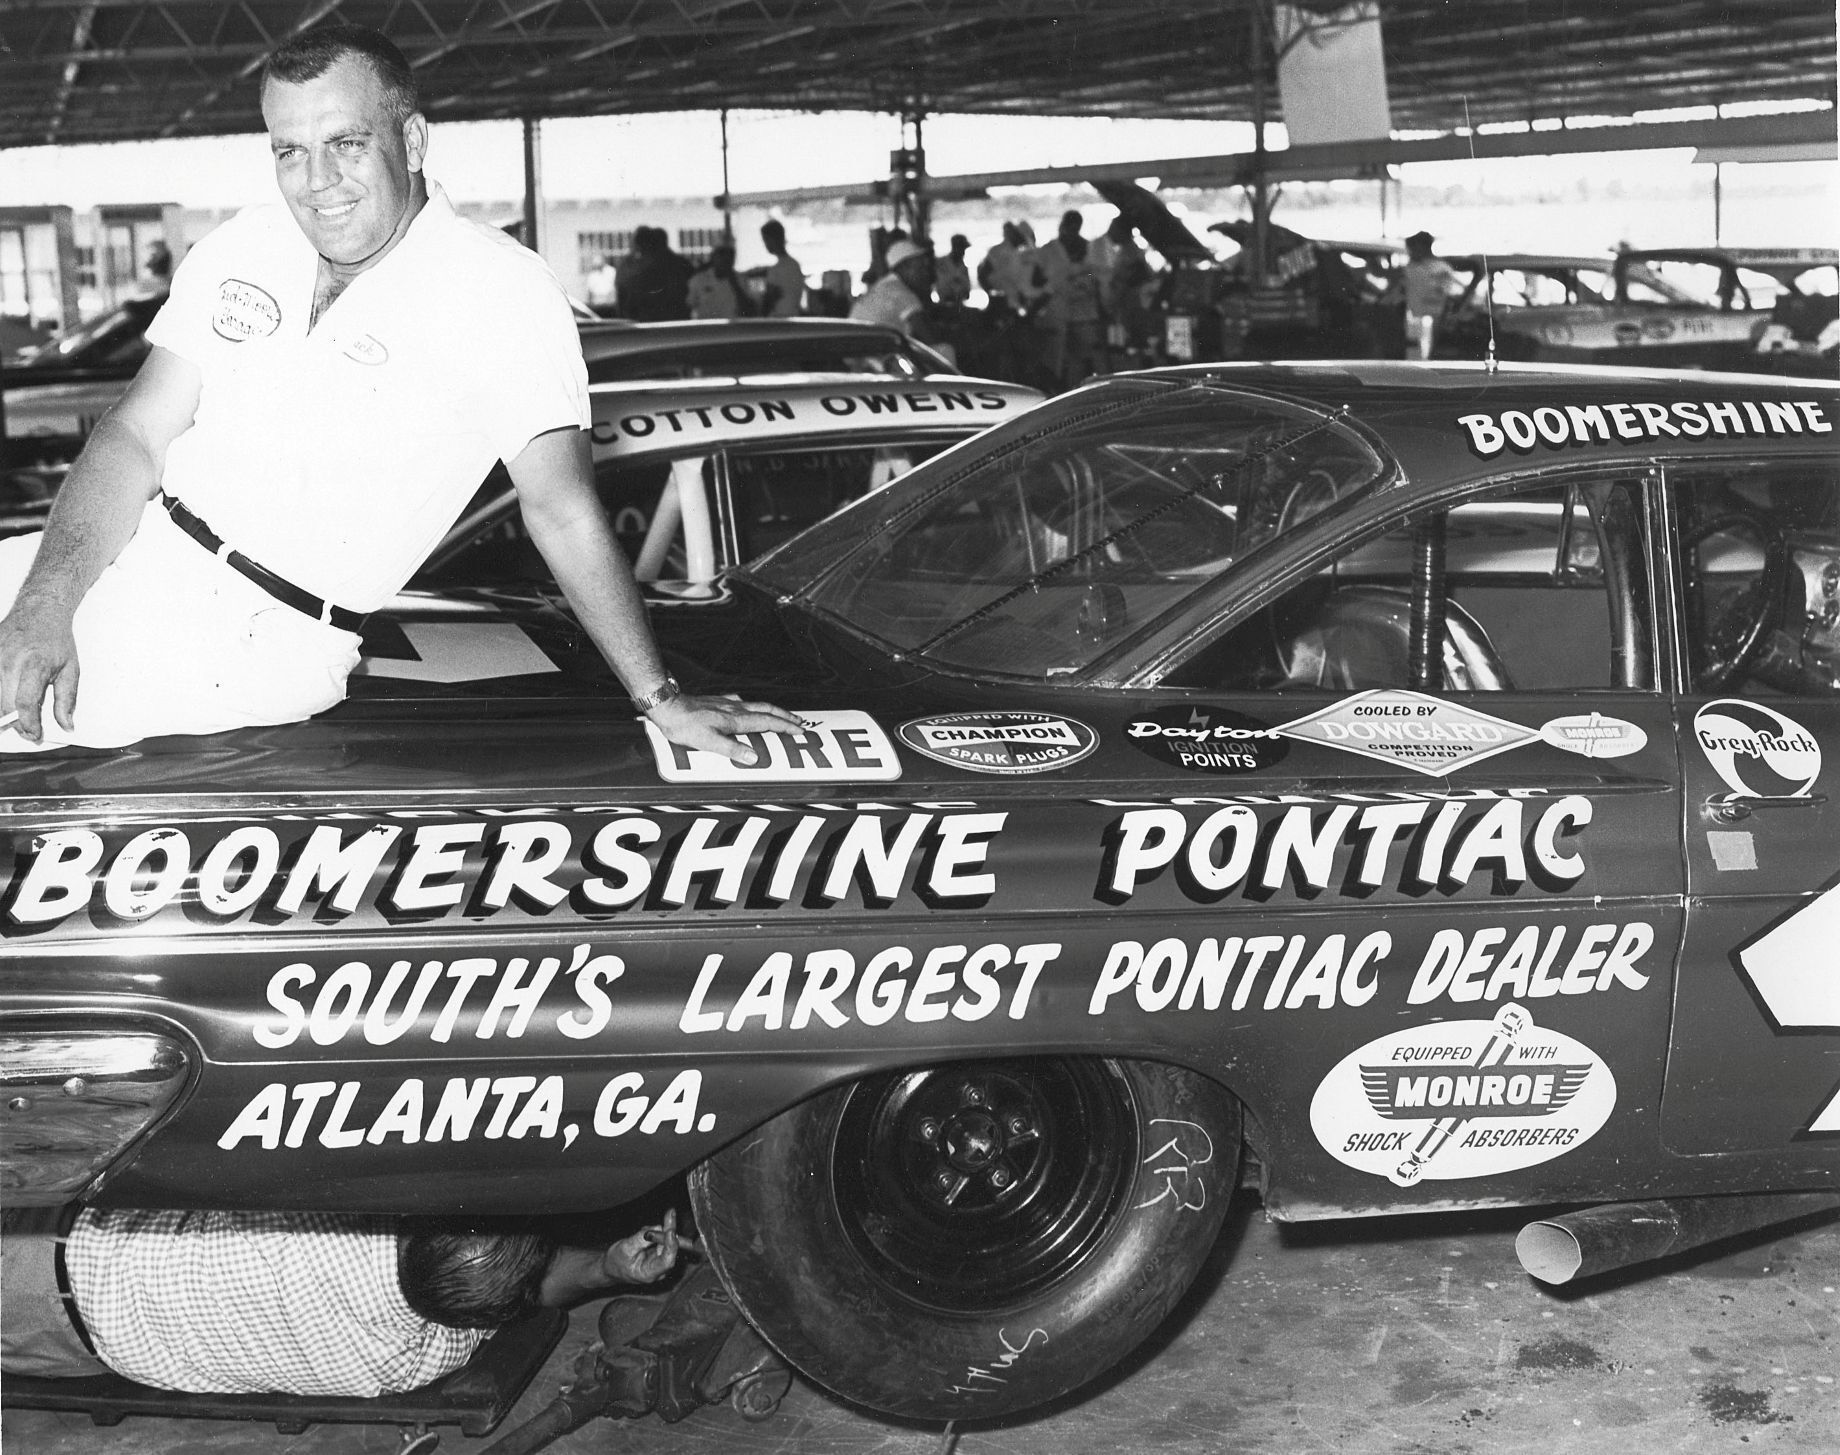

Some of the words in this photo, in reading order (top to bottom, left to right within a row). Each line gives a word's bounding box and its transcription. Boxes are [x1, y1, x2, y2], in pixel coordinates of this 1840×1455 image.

[590, 400, 796, 445] COTTON
[820, 391, 1008, 417] OWENS
[1457, 400, 1834, 455] BOOMERSHINE
[927, 713, 1003, 726] EQUIPPED
[1008, 713, 1051, 723] WITH
[1353, 705, 1411, 716] COOLED
[1417, 705, 1438, 716] BY
[931, 727, 1067, 741] CHAMPION
[1127, 721, 1281, 742] Dayton
[1167, 741, 1259, 754] IGNITION
[1368, 743, 1474, 751] COMPETITION
[1699, 730, 1817, 756] Grey-Rock
[949, 747, 1009, 764] SPARK
[1018, 745, 1069, 764] PLUGS
[1179, 753, 1257, 768] POINTS
[8, 810, 1009, 924] BOOMERSHINE
[1111, 796, 1592, 895] PONTIAC
[252, 943, 626, 1049] SOUTH'S
[678, 942, 1062, 1034] LARGEST
[1088, 930, 1393, 1015] PONTIAC
[1406, 922, 1655, 1005] DEALER
[1391, 1046, 1473, 1061] EQUIPPED
[1518, 1046, 1558, 1060] WITH
[1394, 1074, 1556, 1107] MONROE
[1342, 1132, 1412, 1152] SHOCK
[1459, 1128, 1580, 1149] ABSORBERS
